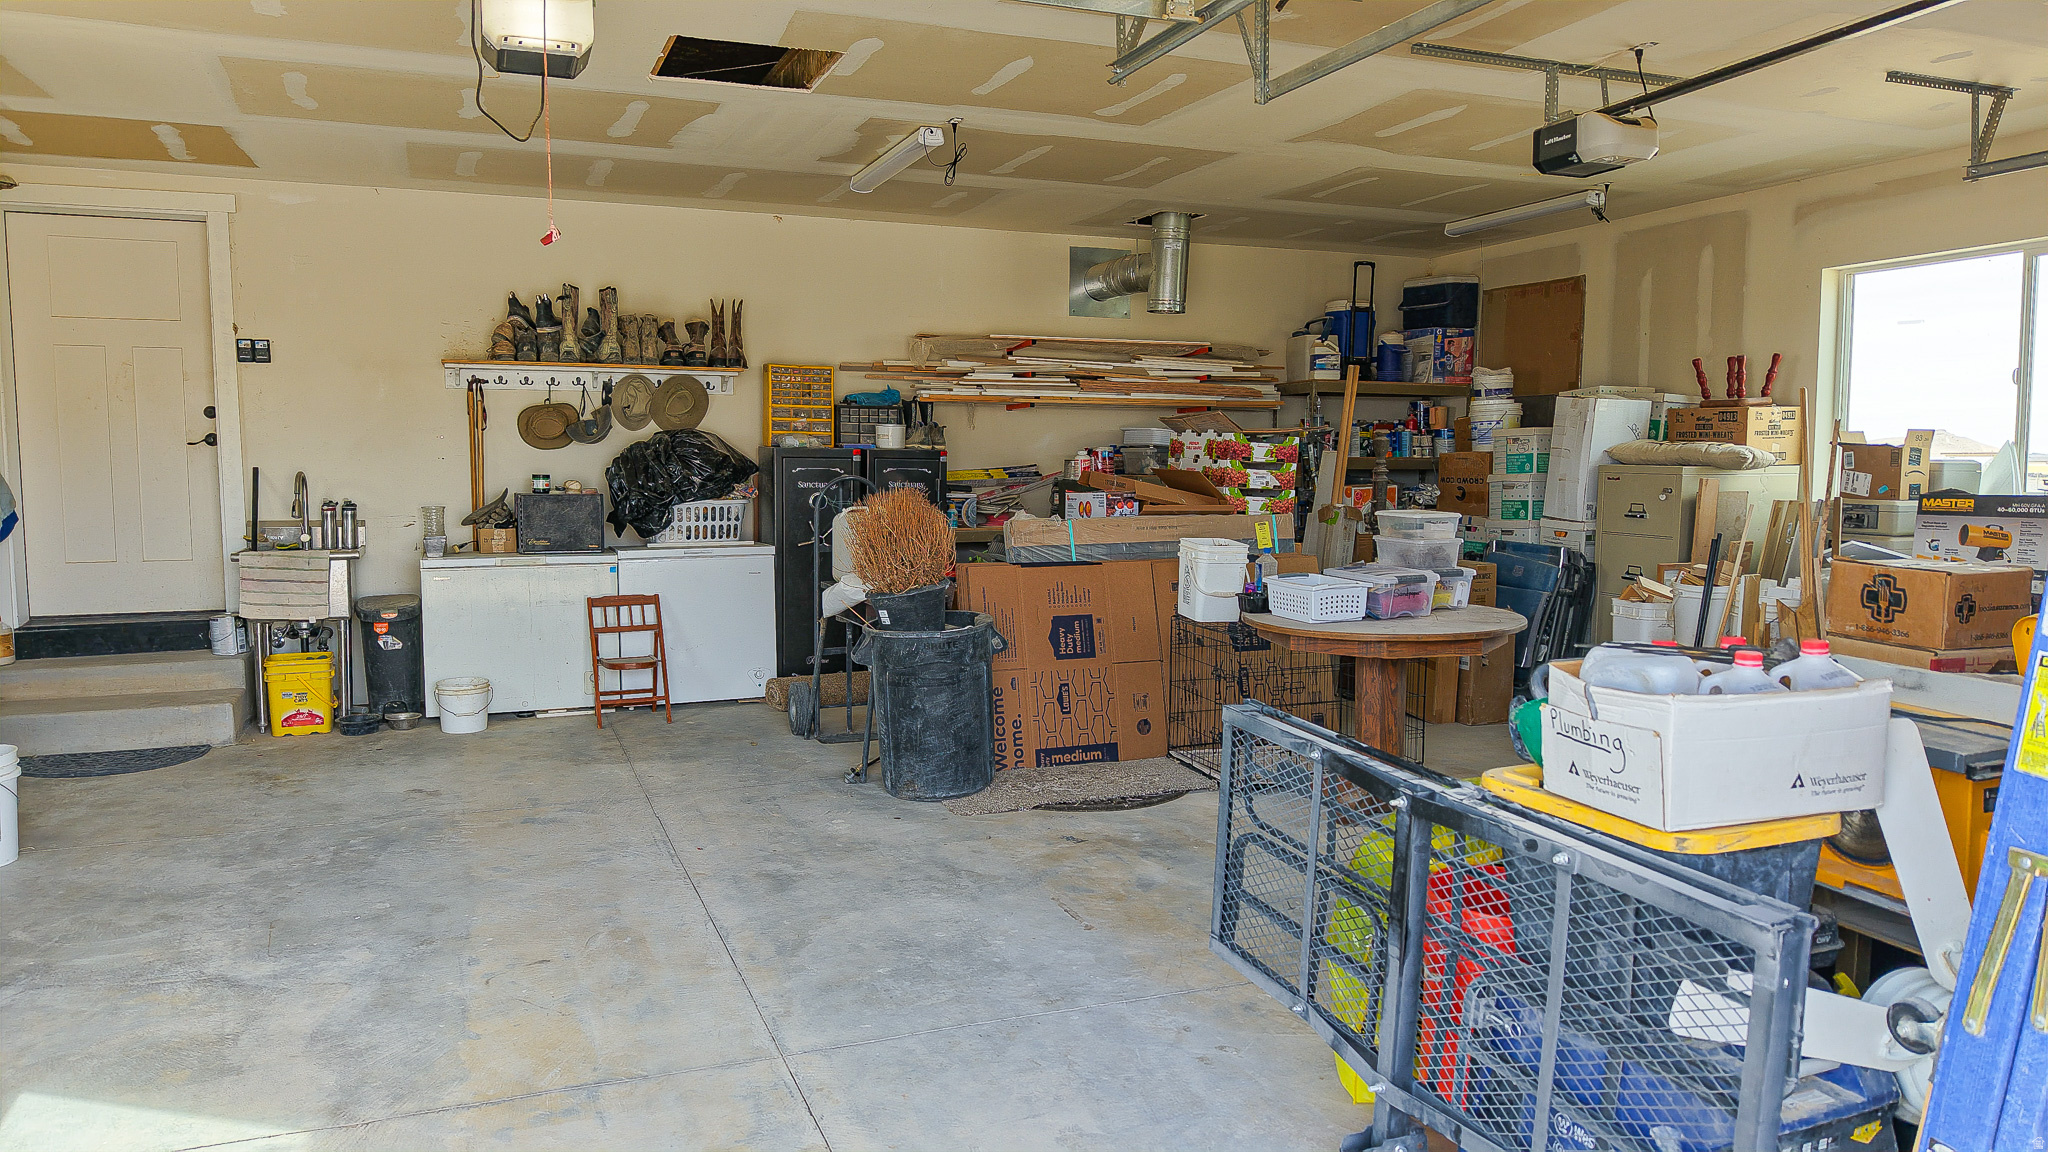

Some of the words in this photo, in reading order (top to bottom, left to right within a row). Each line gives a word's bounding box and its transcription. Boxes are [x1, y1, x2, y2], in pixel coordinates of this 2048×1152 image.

[1719, 412, 1738, 421] 04913
[1675, 431, 1697, 439] FROSTED
[1456, 477, 1484, 485] CROWD
[1921, 498, 1975, 509] MASTER
[1983, 529, 2010, 539] MASTER
[1058, 627, 1066, 655] Heavy
[1066, 633, 1074, 654] Duty
[1074, 620, 1082, 654] medium
[1062, 685, 1071, 713] LOWE'S
[993, 686, 1009, 772] Welcome
[1550, 708, 1626, 774] Plumbing
[1051, 749, 1103, 764] medium
[1583, 768, 1641, 794] Weyerhaeuser
